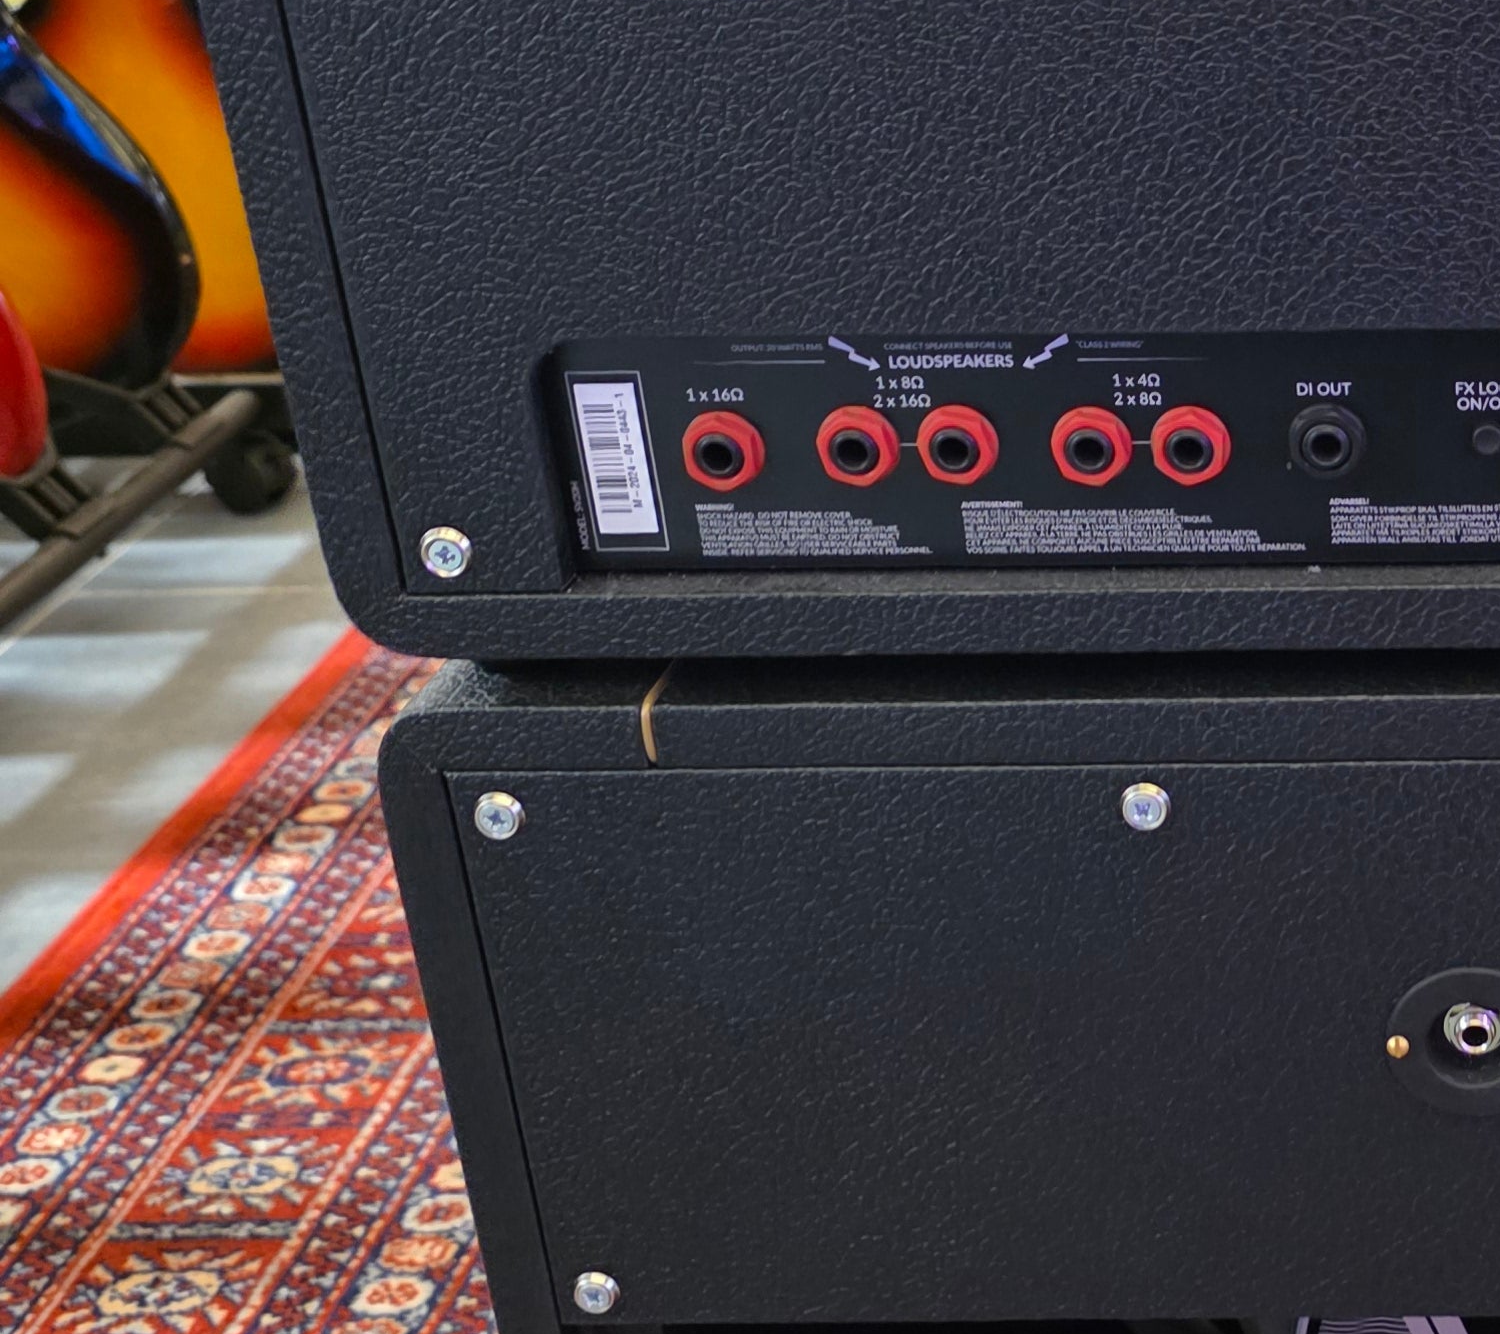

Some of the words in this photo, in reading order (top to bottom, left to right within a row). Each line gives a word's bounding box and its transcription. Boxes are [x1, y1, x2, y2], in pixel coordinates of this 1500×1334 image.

[888, 353, 1014, 369] LOUDSPEAKERS
[876, 376, 885, 390] 1
[889, 379, 898, 389] x
[901, 376, 924, 389] 8Ω
[1113, 374, 1121, 387] 1
[1125, 377, 1134, 387] x
[1137, 374, 1160, 387] 4Ω
[687, 388, 694, 402] 1
[698, 391, 707, 402] x
[711, 387, 744, 402] 16Ω
[1296, 383, 1313, 396] DI
[1316, 382, 1351, 396] OUT
[1455, 382, 1474, 396] FX
[873, 395, 883, 408] 2
[887, 397, 896, 407] x
[900, 394, 931, 408] 16Ω
[1114, 393, 1124, 405] 2
[1128, 395, 1136, 405] x
[1140, 392, 1161, 405] 8Ω
